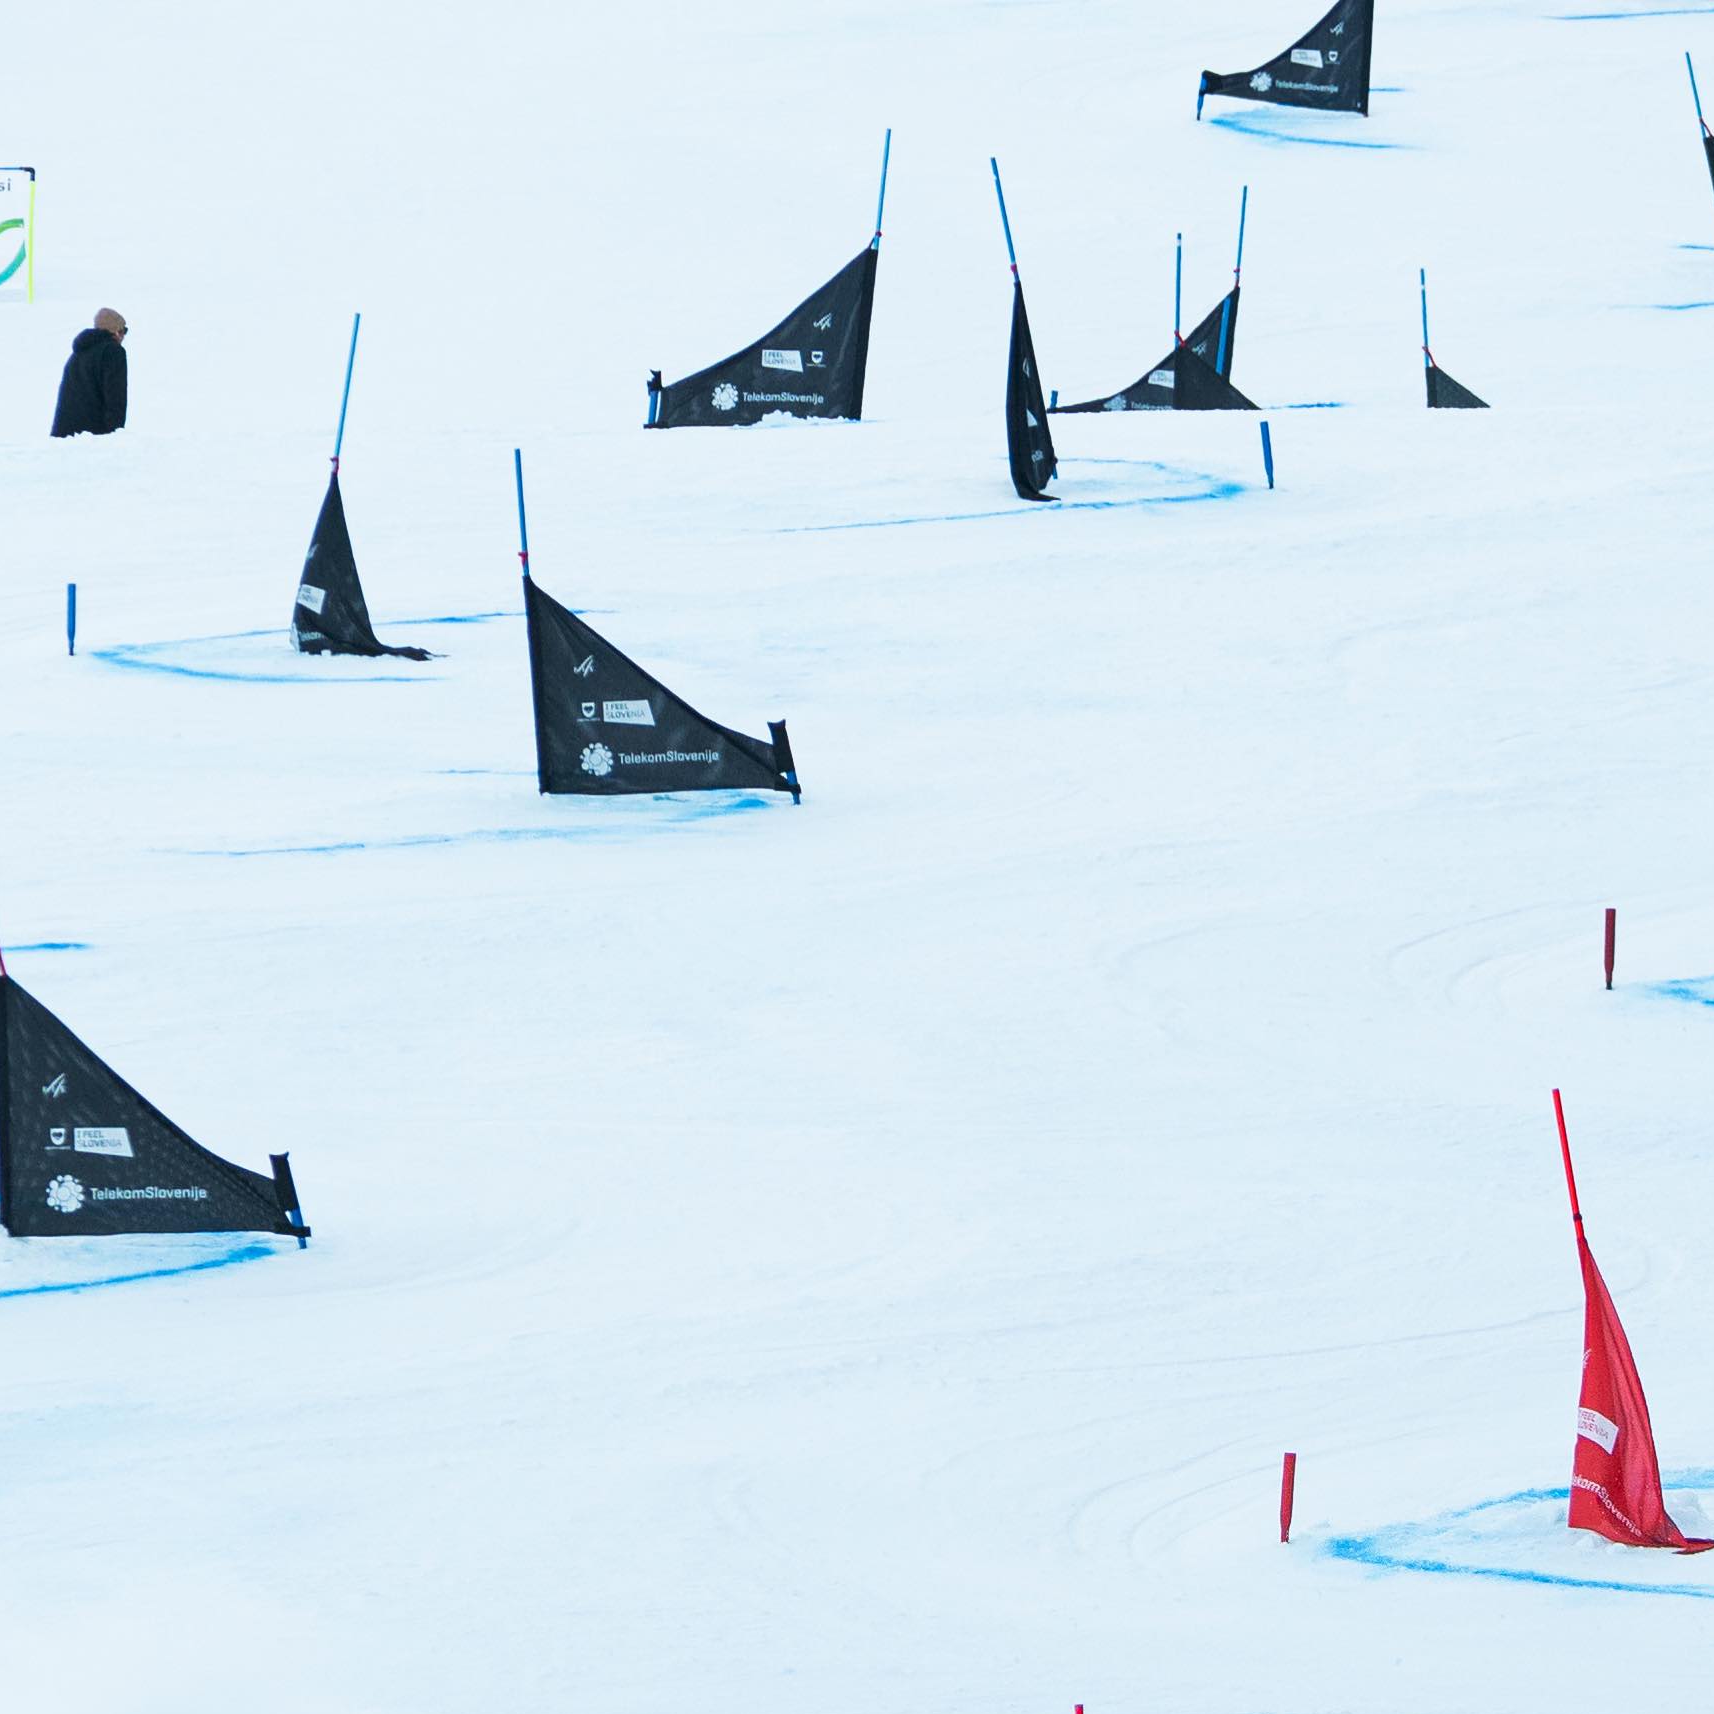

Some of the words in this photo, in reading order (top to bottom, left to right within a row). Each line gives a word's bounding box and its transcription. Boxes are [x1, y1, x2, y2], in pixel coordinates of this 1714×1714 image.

[742, 391, 824, 406] TelekomSlovenije
[618, 752, 721, 765] TelekomSlovenije
[90, 1186, 208, 1203] TelekomSlovenije
